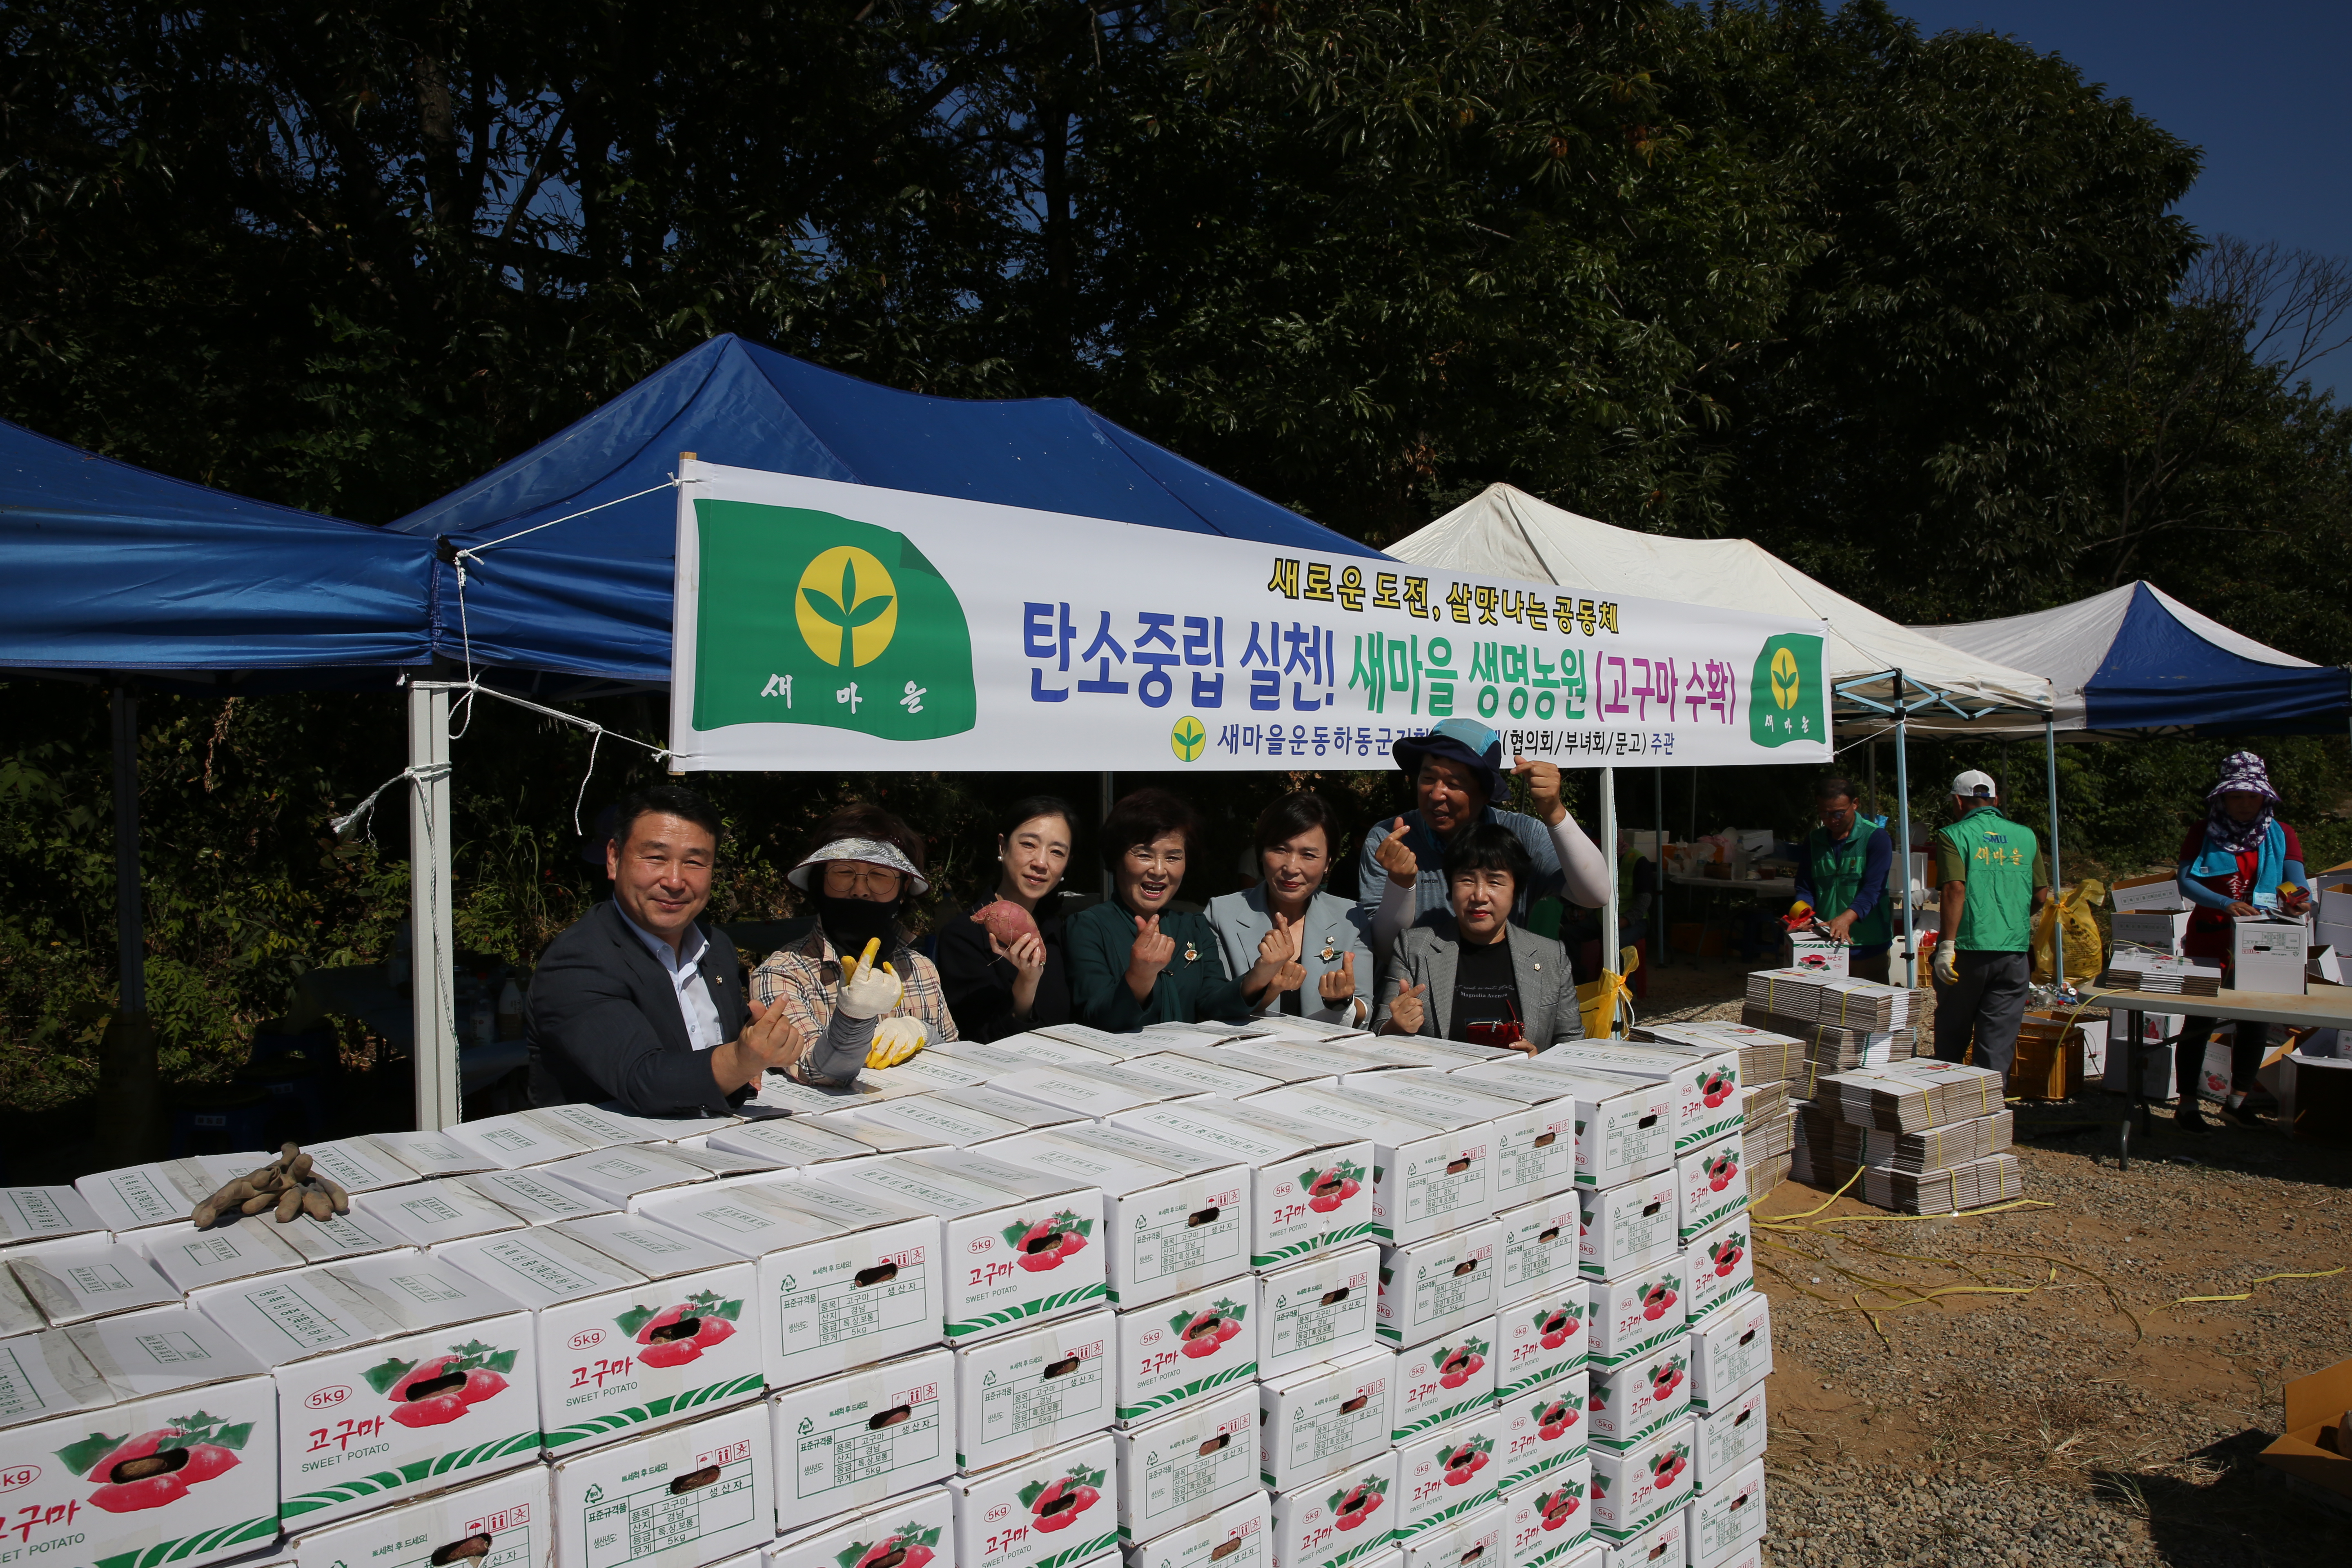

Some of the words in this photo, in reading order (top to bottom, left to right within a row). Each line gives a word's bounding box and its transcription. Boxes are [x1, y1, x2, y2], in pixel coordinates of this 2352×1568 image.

[1267, 557, 1366, 612] 새로운
[1373, 572, 1441, 621] 도전,
[1446, 582, 1548, 631] 살맛나는
[1553, 596, 1619, 636] 공동체
[1023, 602, 1224, 708] 탄소중립
[1239, 621, 1334, 711] 실천!
[1348, 631, 1458, 717] 새마을
[1469, 641, 1587, 720] 생명농원
[1596, 651, 1678, 722] (고구마
[1685, 659, 1736, 725] 수확)
[1494, 729, 1646, 755] (협의회/부녀회/문고)
[1650, 733, 1675, 755] 주관
[1982, 833, 2008, 844] SMU
[1682, 1087, 1692, 1095] 5kg
[1682, 1101, 1702, 1117] 고구마
[1276, 1185, 1290, 1194] 5kg
[1273, 1204, 1306, 1224] 고구마
[1137, 1232, 1160, 1244] 표준규격품
[1182, 1232, 1198, 1241] 고구마
[1269, 1228, 1287, 1238] SWEET
[1289, 1223, 1308, 1232] POTATO
[972, 1240, 991, 1251] 5kg
[1185, 1241, 1195, 1250] 경남
[1695, 1259, 1704, 1269] 5kg
[969, 1261, 1014, 1286] 고구마
[1696, 1272, 1714, 1290] 고구마
[784, 1294, 816, 1309] 표준규격품
[821, 1301, 836, 1312] 품목
[846, 1293, 869, 1305] 고구마
[966, 1292, 989, 1303] SWEET
[992, 1285, 1018, 1296] POTATO
[822, 1312, 836, 1322] 산지
[851, 1305, 865, 1315] 경남
[822, 1322, 837, 1333] 등급
[822, 1333, 837, 1343] 무게
[851, 1327, 866, 1335] 5kg
[1515, 1327, 1527, 1337] 5kg
[574, 1332, 601, 1347] 5kg
[1143, 1332, 1160, 1343] 5kg
[1512, 1343, 1538, 1361] 고구마
[1140, 1350, 1178, 1374] 고구마
[1510, 1363, 1523, 1372] SWEET
[1525, 1357, 1539, 1365] POTATO
[570, 1356, 633, 1388] 고구마
[1137, 1376, 1157, 1388] SWEET
[1159, 1368, 1181, 1380] POTATO
[1412, 1366, 1425, 1377] 5kg
[311, 1389, 345, 1405] 5kg
[566, 1391, 599, 1406] SWEET
[603, 1381, 638, 1396] POTATO
[1408, 1382, 1437, 1403] 고구마
[1405, 1403, 1420, 1414] SWEET
[1422, 1397, 1439, 1407] POTATO
[307, 1415, 385, 1452] 고구마
[1512, 1419, 1524, 1430] 5kg
[800, 1435, 833, 1452] 표준규격품
[837, 1441, 851, 1452] 품목
[862, 1433, 884, 1445] 고구마
[1510, 1434, 1536, 1453] 고구마
[302, 1454, 342, 1472] SWEET
[347, 1443, 390, 1460] POTATO
[837, 1452, 851, 1463] 산지
[866, 1444, 880, 1454] 경남
[1508, 1454, 1521, 1464] SWEET
[1523, 1448, 1538, 1458] POTATO
[837, 1463, 852, 1474] 등급
[837, 1473, 851, 1484] 무게
[865, 1466, 880, 1475] 5kg
[1416, 1464, 1429, 1475] 5kg
[0, 1470, 31, 1487] kg
[1413, 1479, 1441, 1501] 고구마
[588, 1503, 626, 1522] 표준규격품
[632, 1508, 650, 1523] 품목
[662, 1497, 688, 1511] 고구마
[1410, 1502, 1425, 1513] SWEET
[1426, 1495, 1443, 1505] POTATO
[633, 1521, 650, 1533] 산지
[667, 1510, 684, 1522] 경남
[988, 1507, 1007, 1520] 5kg
[1305, 1510, 1319, 1523] 5kg
[1517, 1511, 1528, 1523] 5kg
[29, 1533, 85, 1556] POTATO
[633, 1532, 650, 1545] 등급
[634, 1544, 651, 1556] 무게
[668, 1534, 686, 1545] 5kg
[985, 1525, 1029, 1555] 고구마
[1301, 1525, 1332, 1550] 고구마
[1515, 1526, 1539, 1547] 고구마
[982, 1555, 1004, 1568] SWEET
[1007, 1545, 1032, 1559] POTATO
[1298, 1551, 1314, 1564] SWEET
[1316, 1543, 1334, 1555] POTATO
[1514, 1548, 1527, 1559] SWEET
[1528, 1540, 1542, 1551] POTATO
